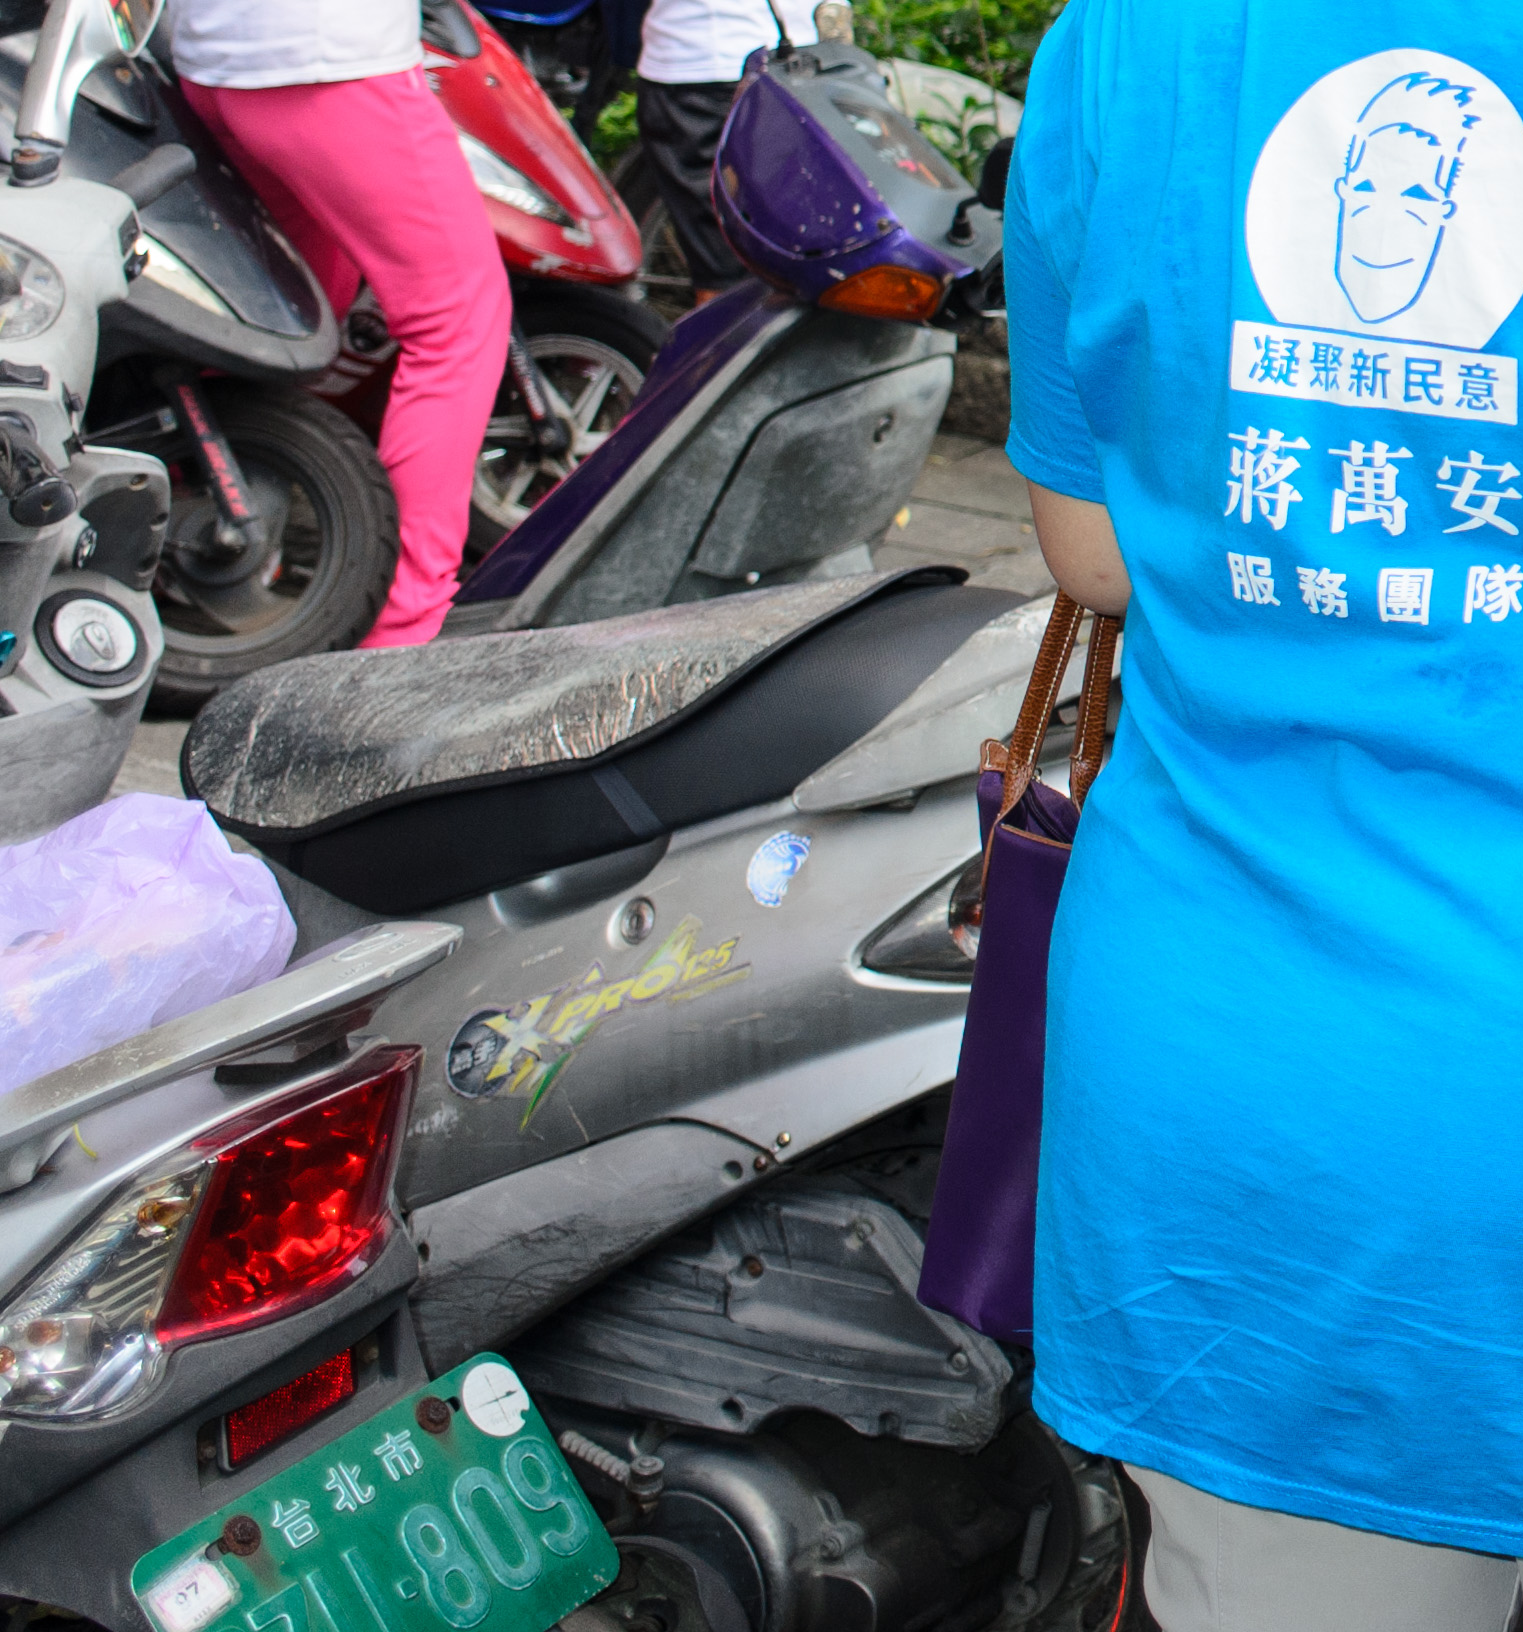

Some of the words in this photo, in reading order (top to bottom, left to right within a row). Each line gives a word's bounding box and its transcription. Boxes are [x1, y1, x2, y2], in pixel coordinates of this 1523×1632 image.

[1250, 333, 1501, 412] 凝聚新民意
[1224, 425, 1523, 536] 蔣萬安
[271, 1429, 425, 1550] 台北市
